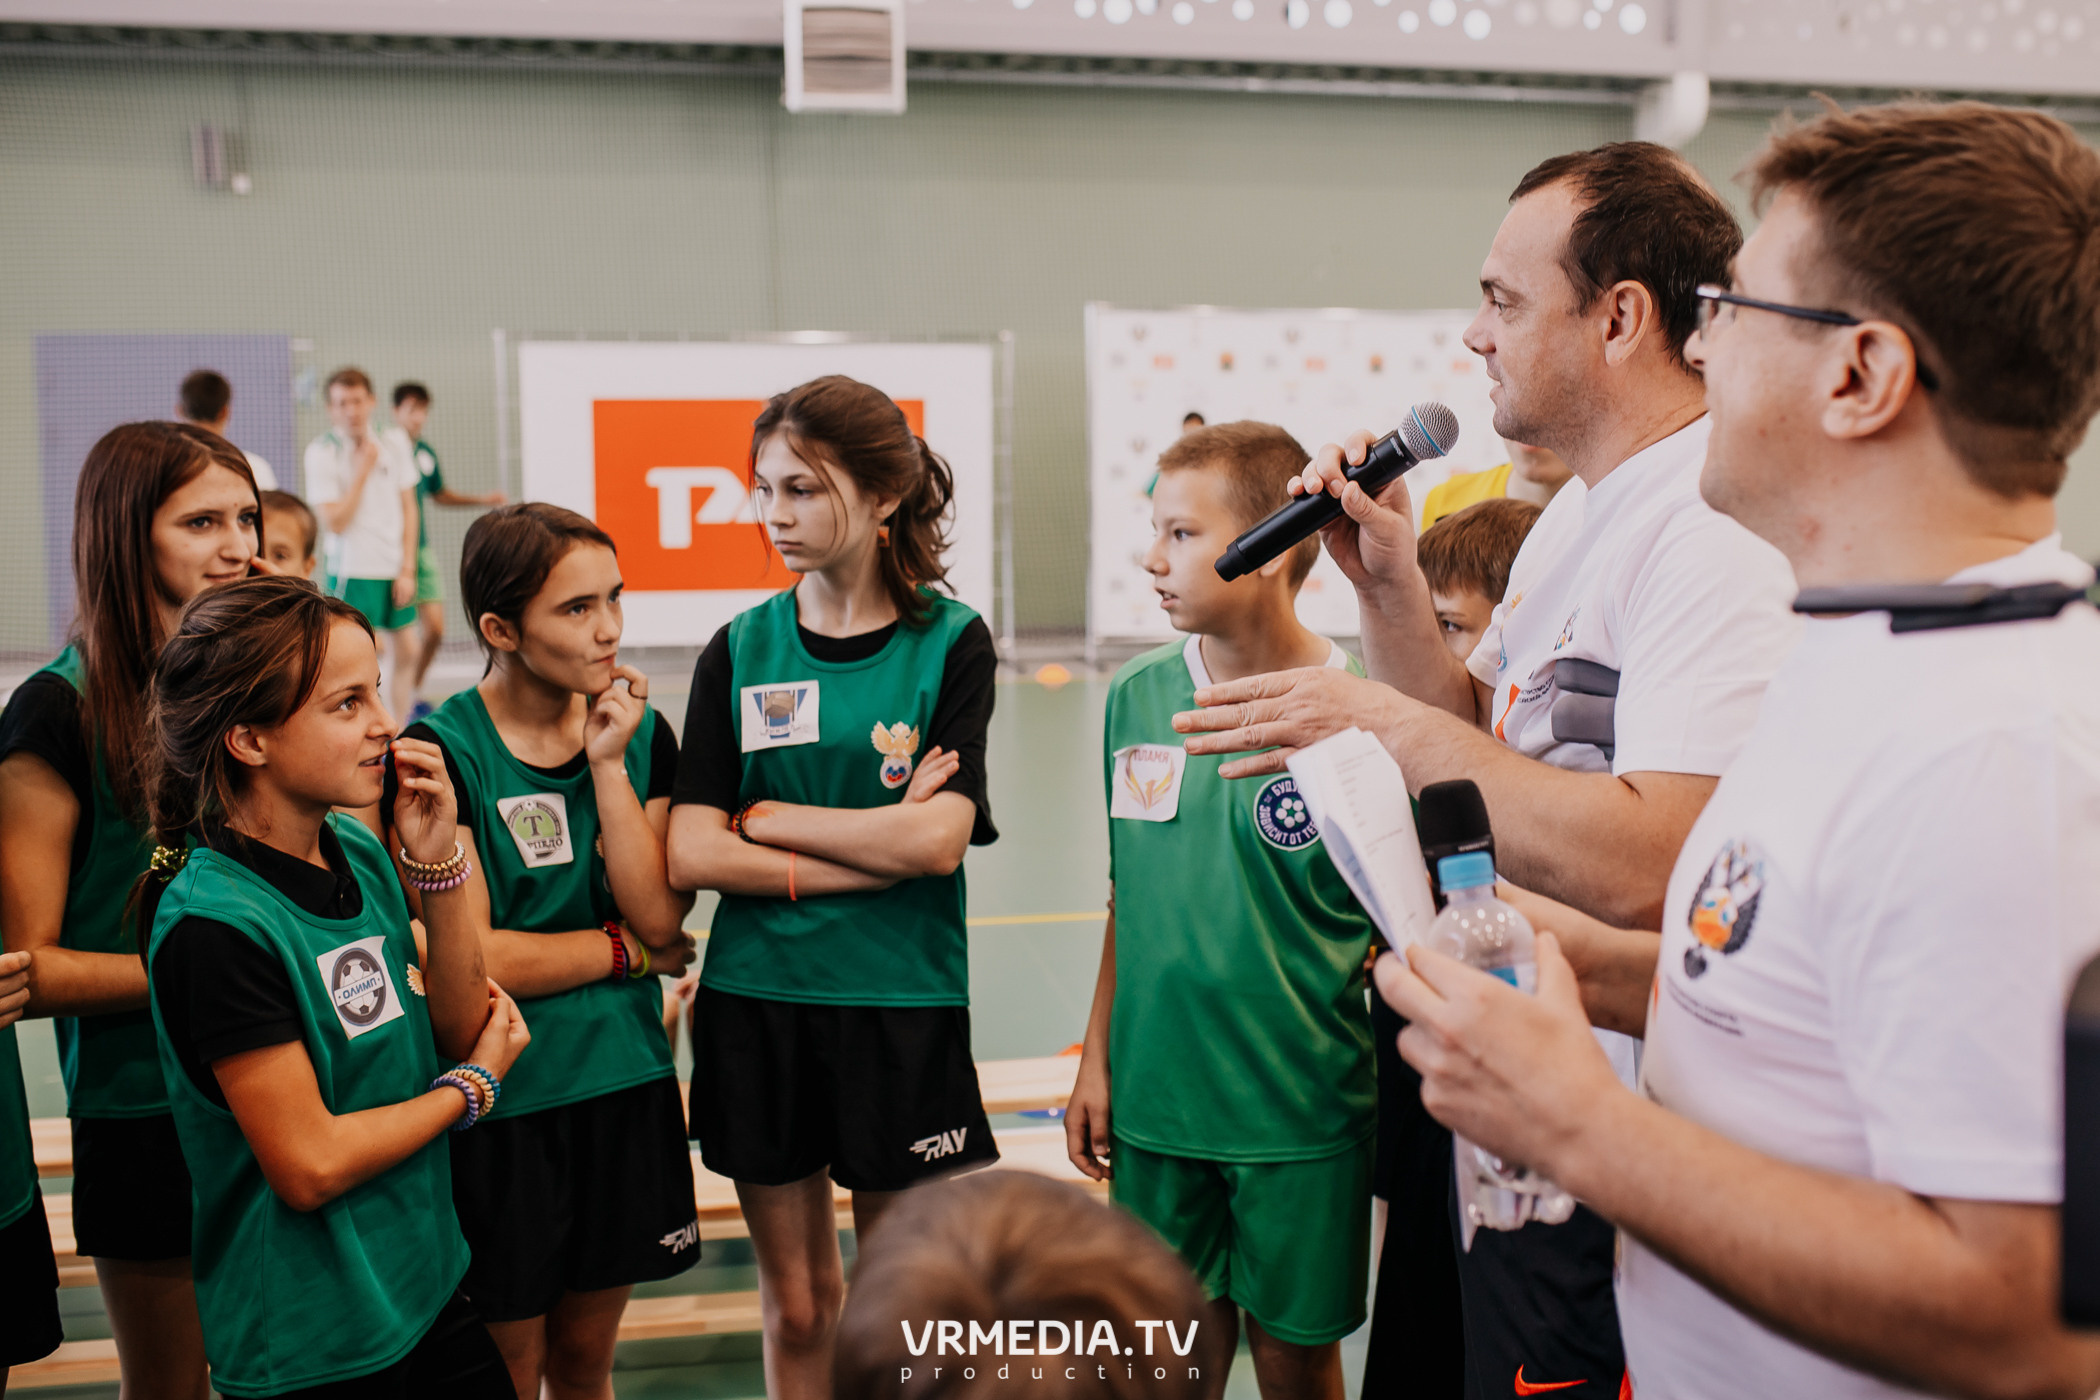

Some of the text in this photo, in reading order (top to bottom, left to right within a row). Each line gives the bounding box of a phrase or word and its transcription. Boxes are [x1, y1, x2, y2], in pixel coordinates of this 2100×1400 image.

[1289, 832, 1302, 845] ОТ
[342, 977, 377, 999] ОЛИМП
[909, 1127, 967, 1162] RAY
